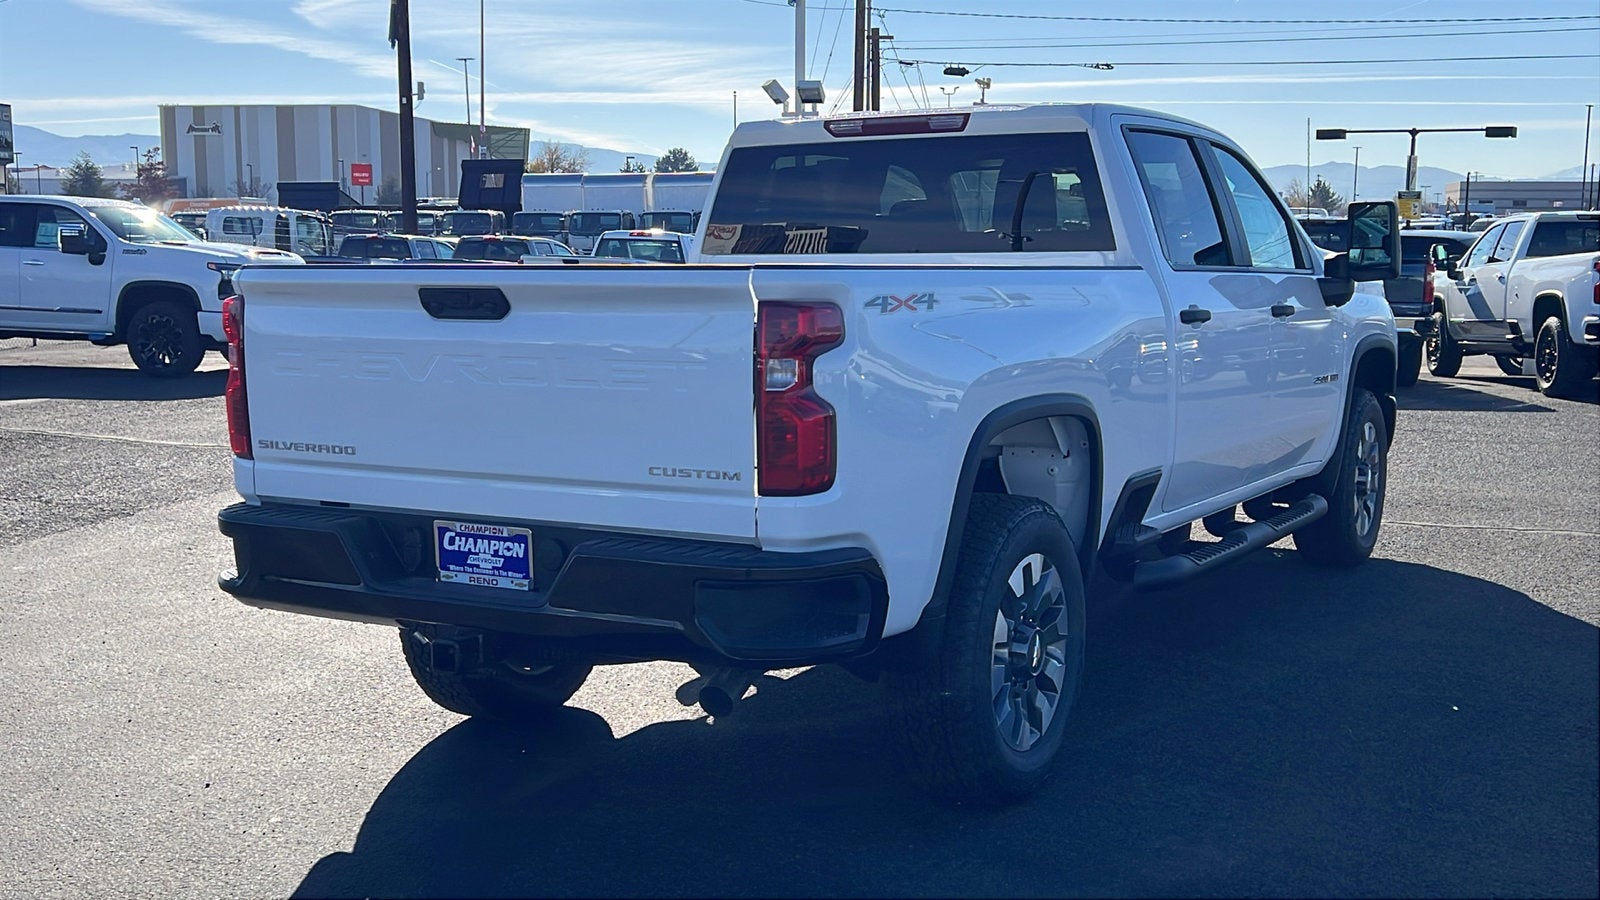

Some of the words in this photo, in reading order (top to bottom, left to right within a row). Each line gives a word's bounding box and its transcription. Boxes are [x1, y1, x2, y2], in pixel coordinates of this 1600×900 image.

[272, 347, 708, 392] CHEVROLET
[258, 439, 357, 456] SILVERADO
[648, 466, 741, 481] CUSTOM
[460, 524, 504, 535] CHAMPION
[443, 532, 525, 558] CHAMPION
[469, 556, 501, 565] CHEVROLET
[469, 576, 499, 586] RENO
